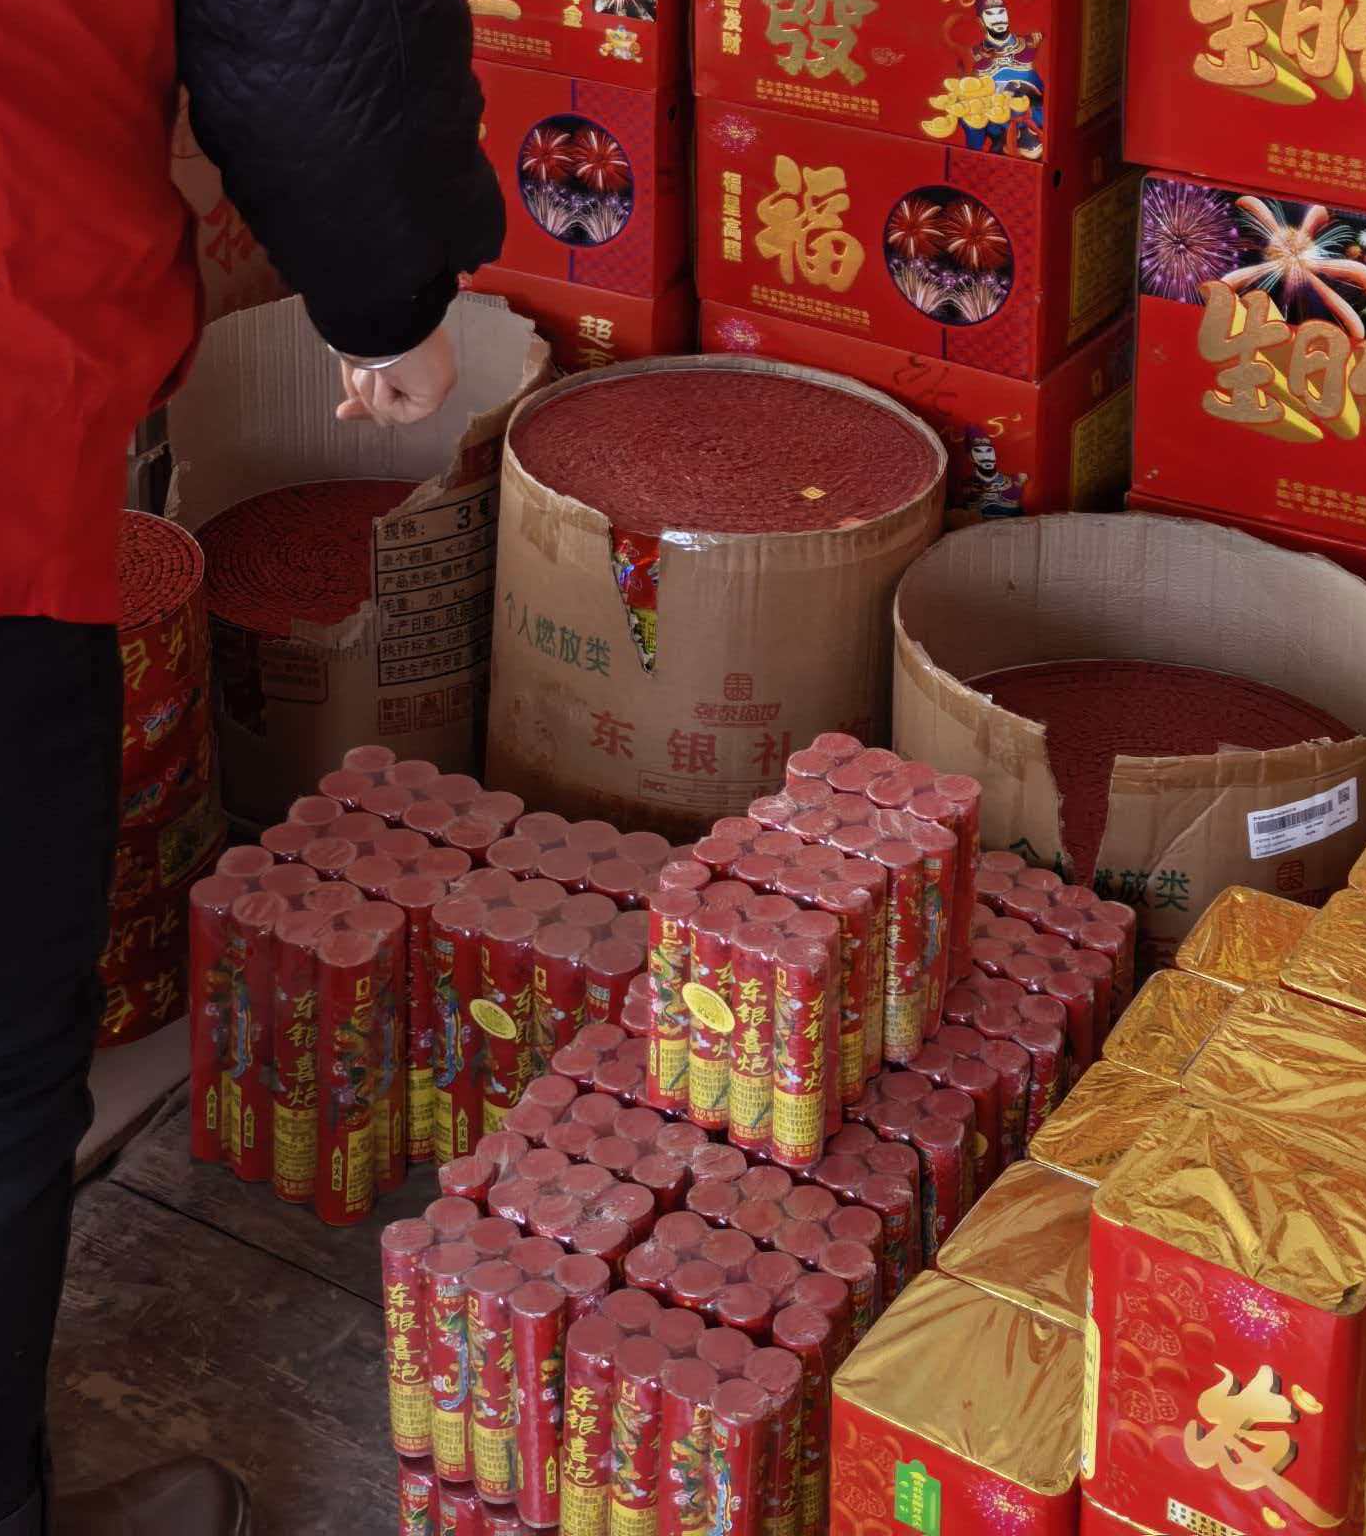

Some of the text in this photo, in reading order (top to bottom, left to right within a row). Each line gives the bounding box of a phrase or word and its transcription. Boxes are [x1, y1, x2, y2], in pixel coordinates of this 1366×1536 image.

[756, 155, 866, 294] 福
[504, 591, 612, 678] 个人燃放类
[736, 977, 773, 1076] 东银喜炮
[387, 1283, 422, 1385] 东银喜炮
[565, 1386, 602, 1487] 东银喜炮
